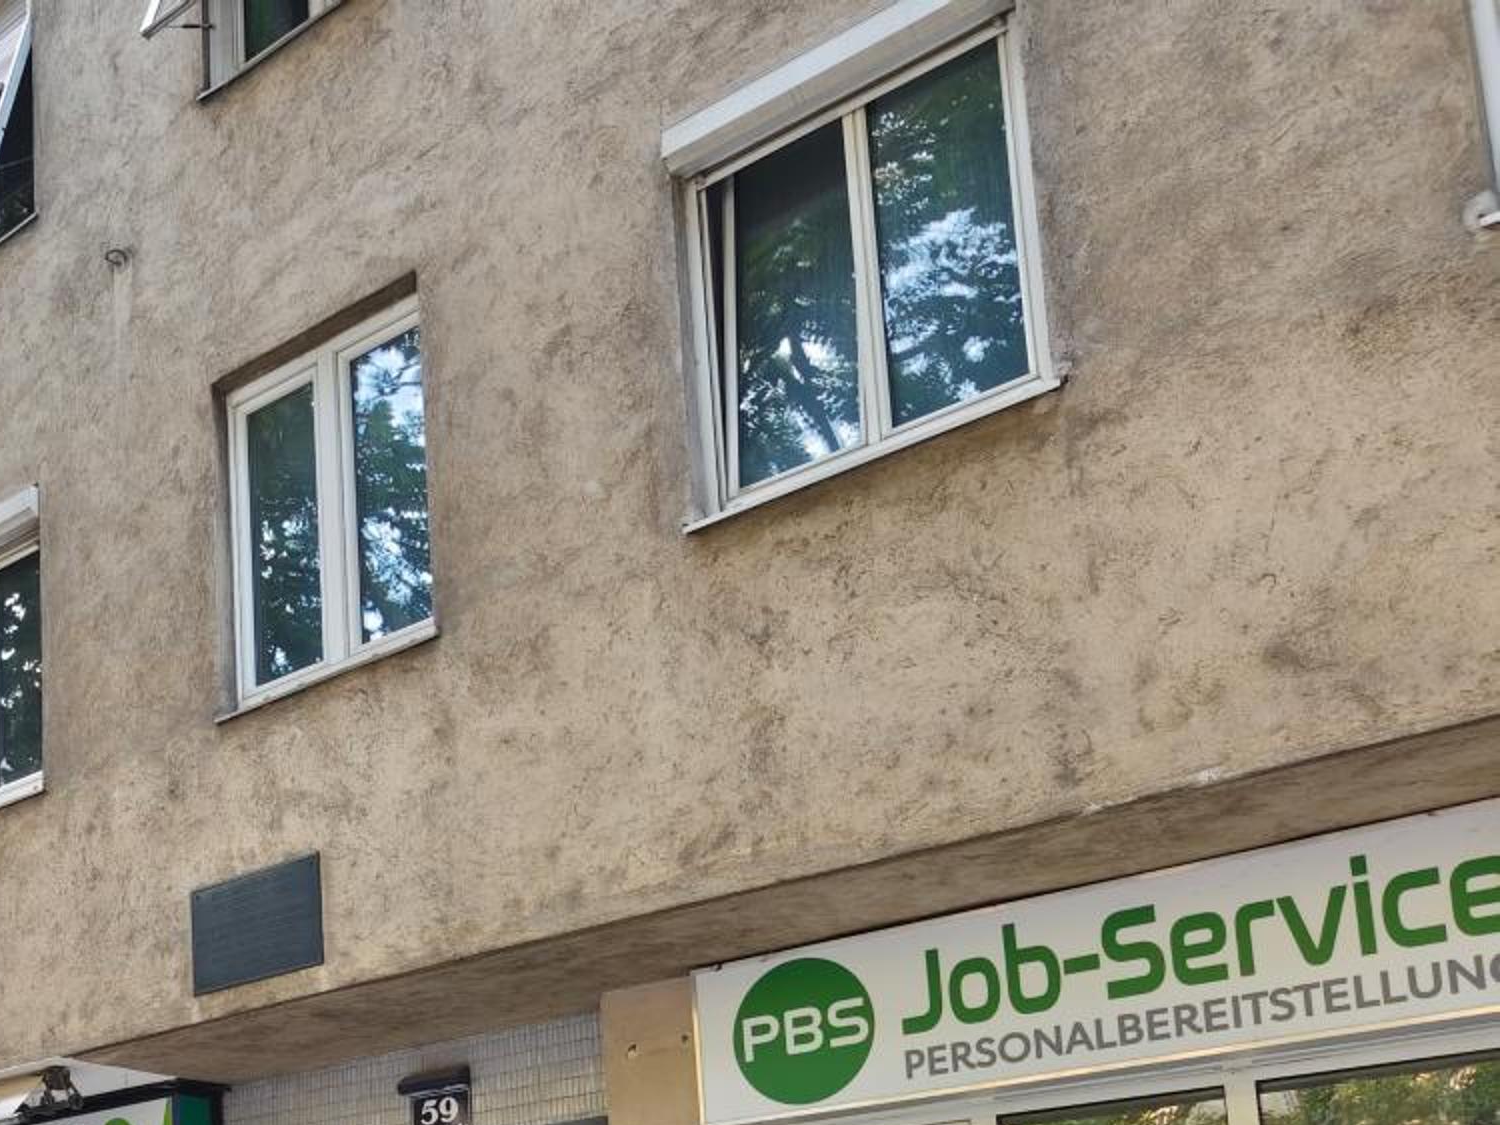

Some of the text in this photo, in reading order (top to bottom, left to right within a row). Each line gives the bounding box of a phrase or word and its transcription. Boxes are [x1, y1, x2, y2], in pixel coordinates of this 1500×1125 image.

[902, 854, 1500, 1037] Job-Service
[742, 996, 870, 1063] PBS
[421, 1097, 459, 1125] 59
